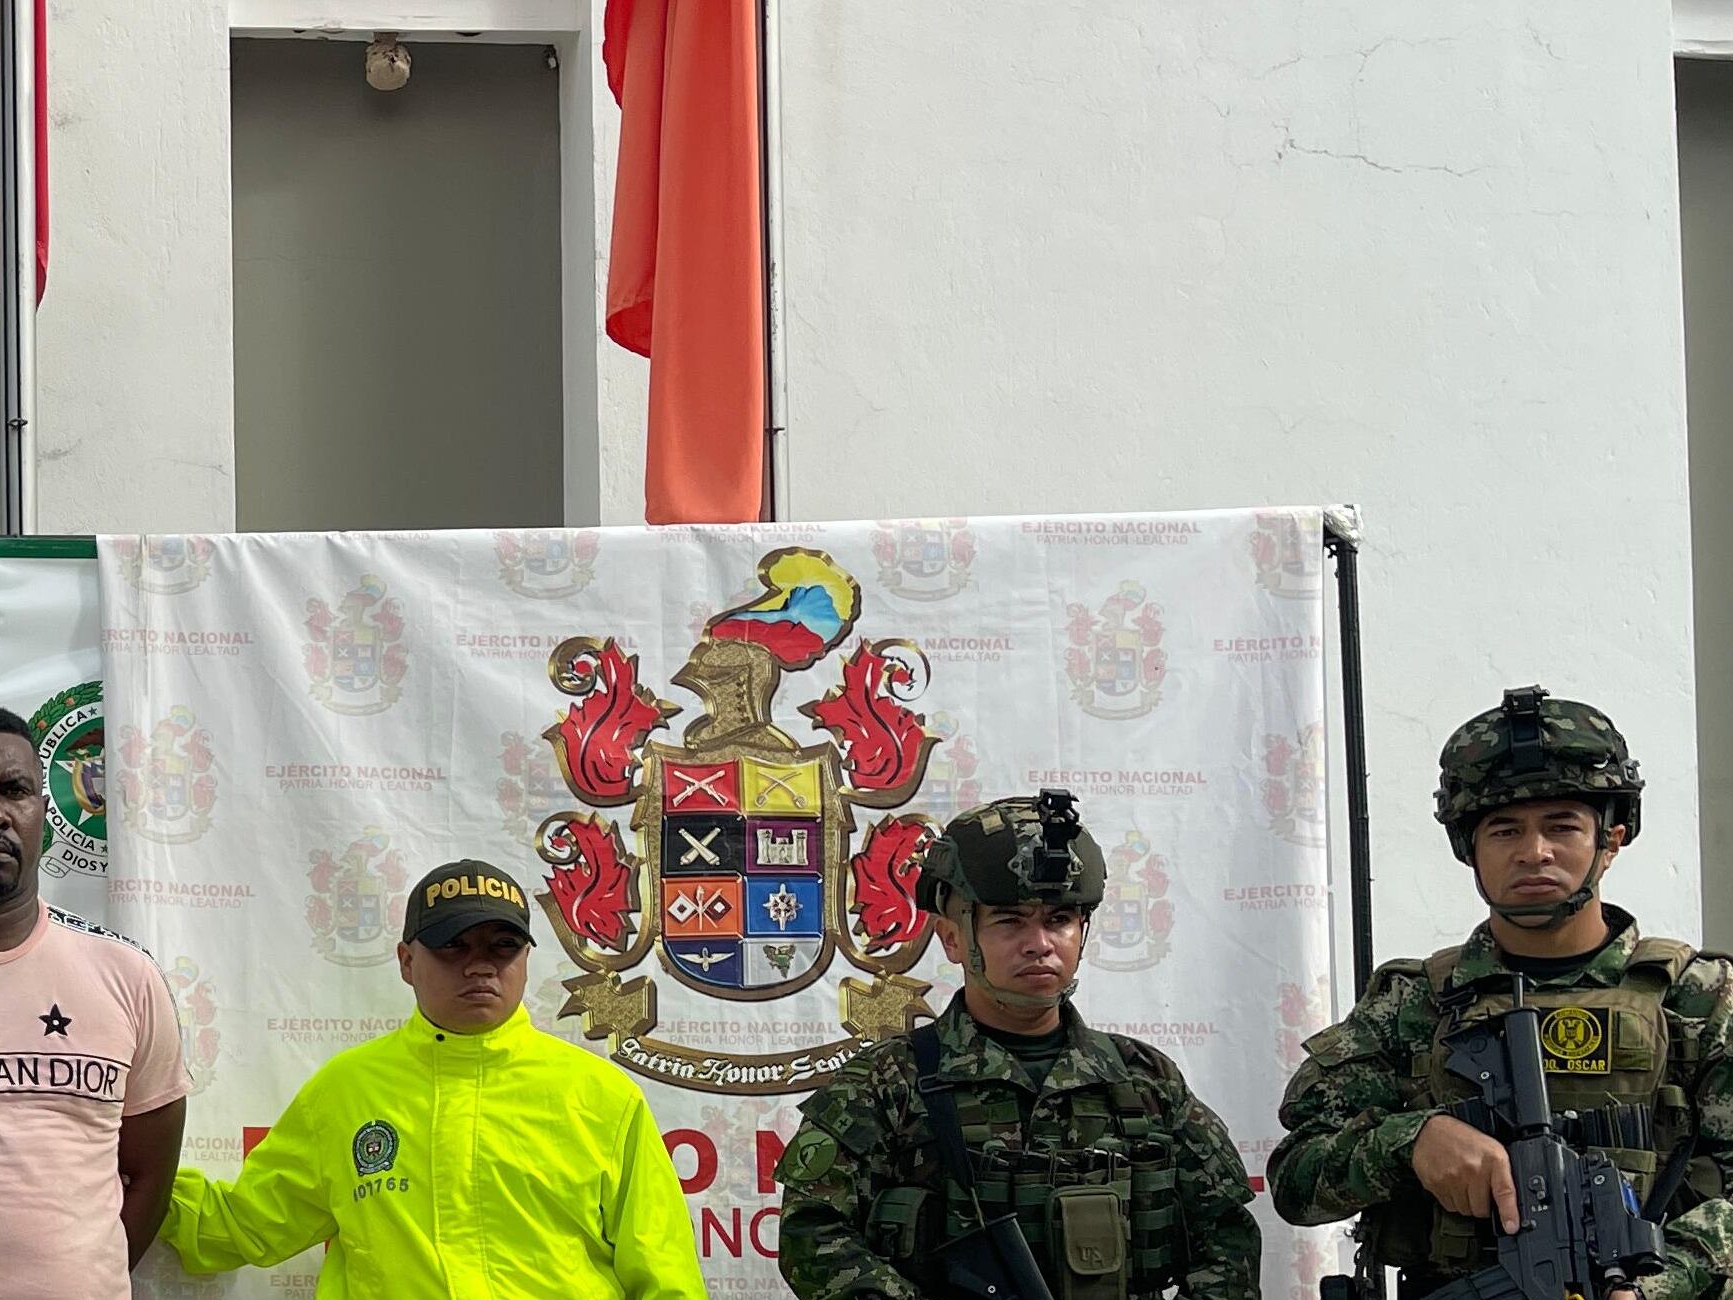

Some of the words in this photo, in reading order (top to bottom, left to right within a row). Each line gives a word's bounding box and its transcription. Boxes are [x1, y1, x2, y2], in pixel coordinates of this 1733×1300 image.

[1111, 521, 1202, 534] NACIONAL
[164, 632, 254, 644] NACIONAL
[925, 638, 1014, 650] NACIONAL
[357, 766, 446, 780] NACIONAL
[1119, 771, 1207, 783] NACIONAL
[169, 881, 254, 897] NACIONAL
[426, 875, 525, 909] POLICIA
[746, 1021, 837, 1034] NACIONAL
[1126, 1021, 1219, 1035] NACIONAL
[1567, 1060, 1606, 1070] OSCAR
[49, 1060, 120, 1095] DIOR
